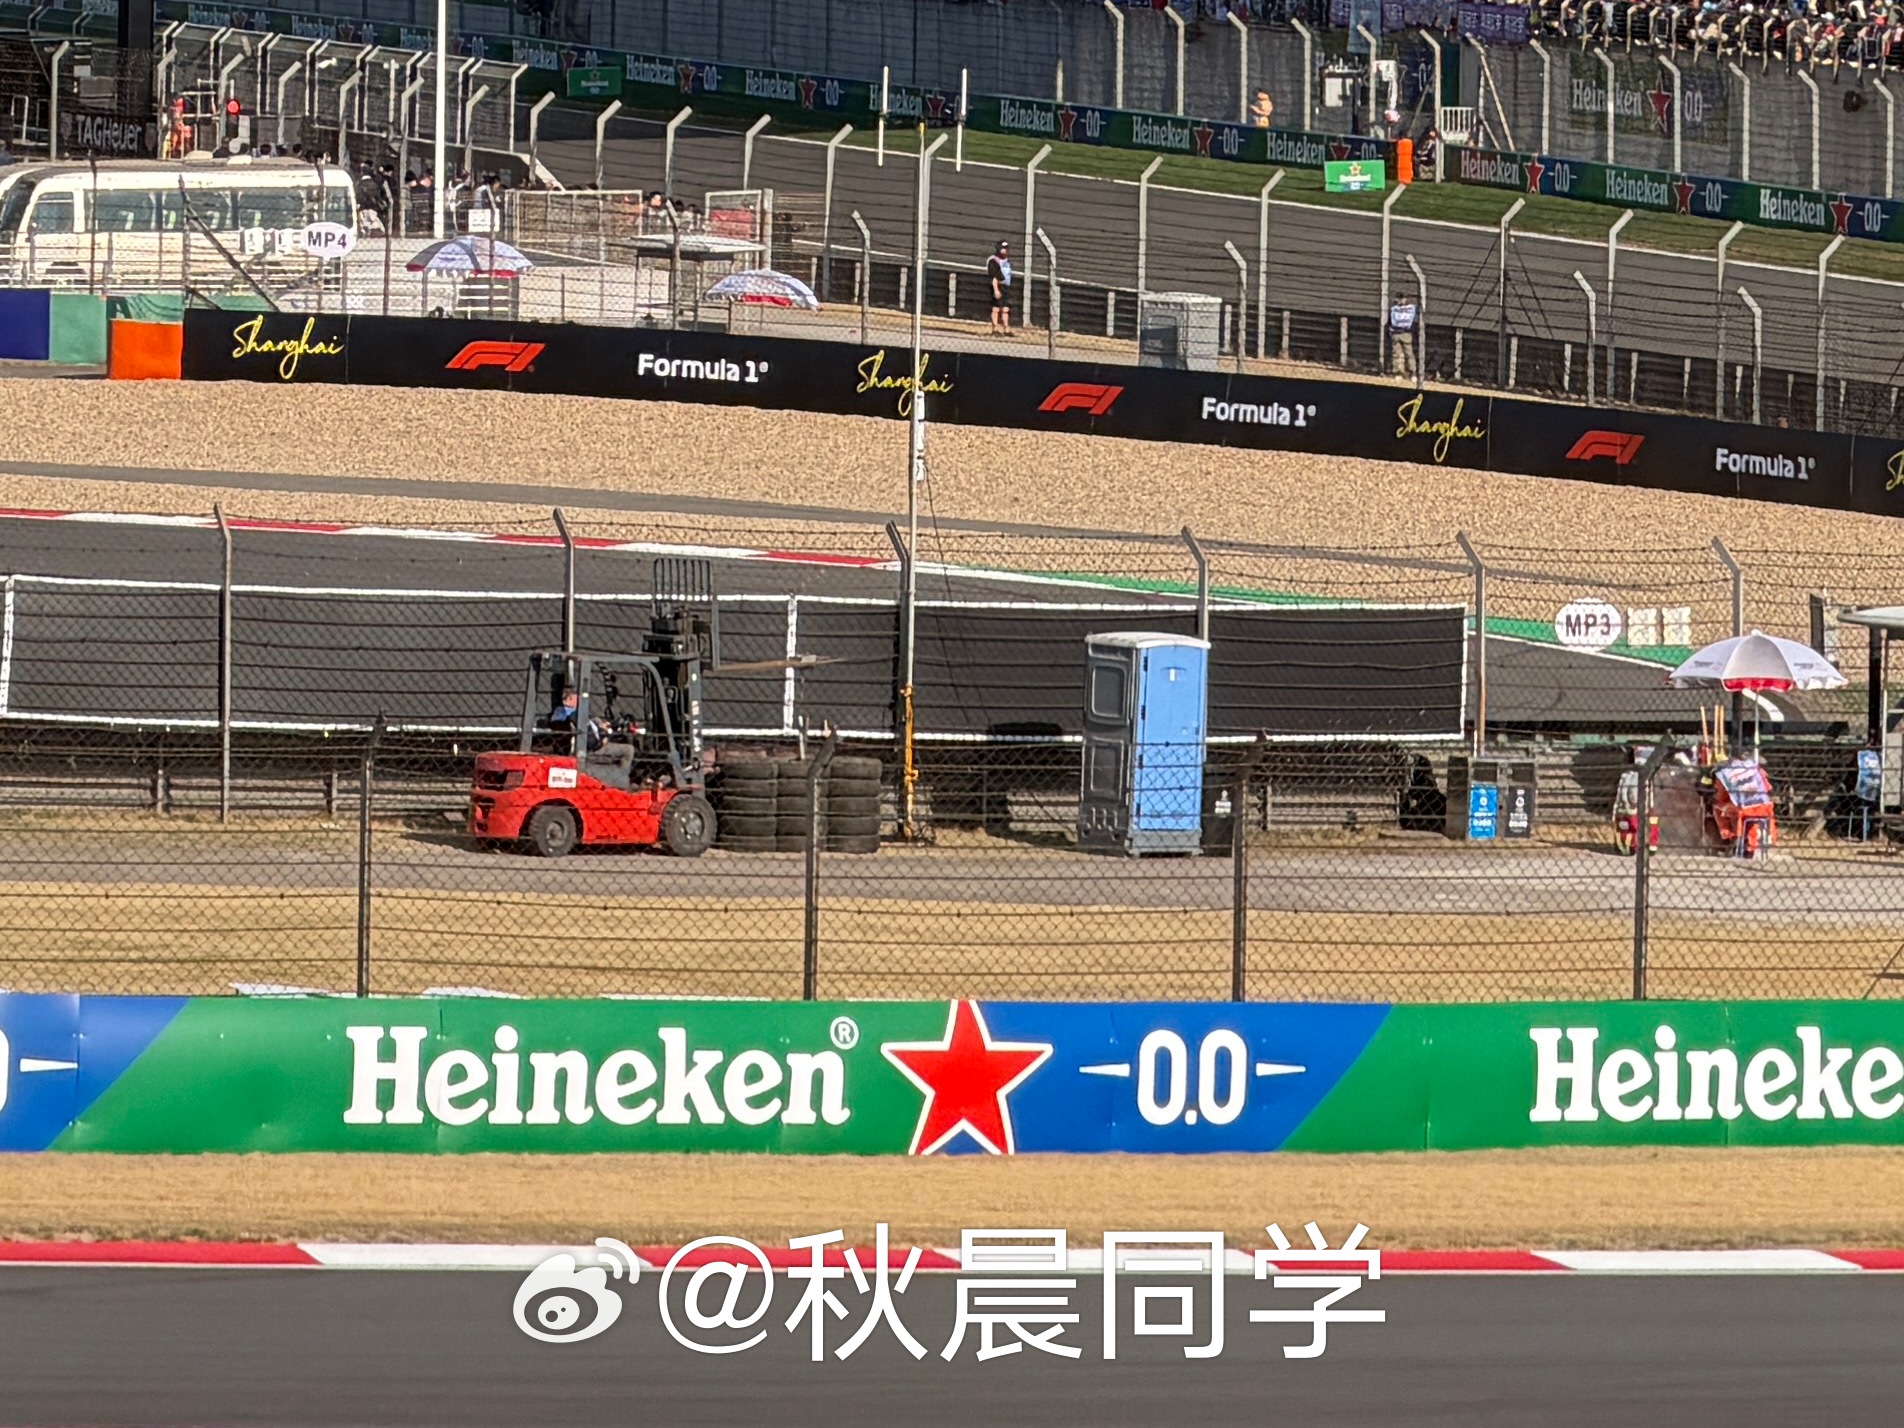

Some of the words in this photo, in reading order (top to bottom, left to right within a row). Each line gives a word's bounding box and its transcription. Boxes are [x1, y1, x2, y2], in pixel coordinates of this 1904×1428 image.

[1572, 78, 1643, 116] Heinken
[1000, 99, 1054, 132] Heineken
[1132, 116, 1190, 150] Heineken
[1461, 150, 1520, 185] Heineken
[1605, 169, 1669, 206] Heineken
[1759, 189, 1826, 226] Heineken
[307, 230, 347, 248] MP4
[232, 316, 344, 380] Shanghai
[637, 352, 741, 382] Formula
[857, 349, 953, 417] Shanghai
[1201, 396, 1291, 426] Formula
[1396, 393, 1486, 462] Shanghai
[1715, 447, 1795, 479] Formula
[1565, 613, 1611, 637] MP3
[1137, 1029, 1247, 1125] 0.0
